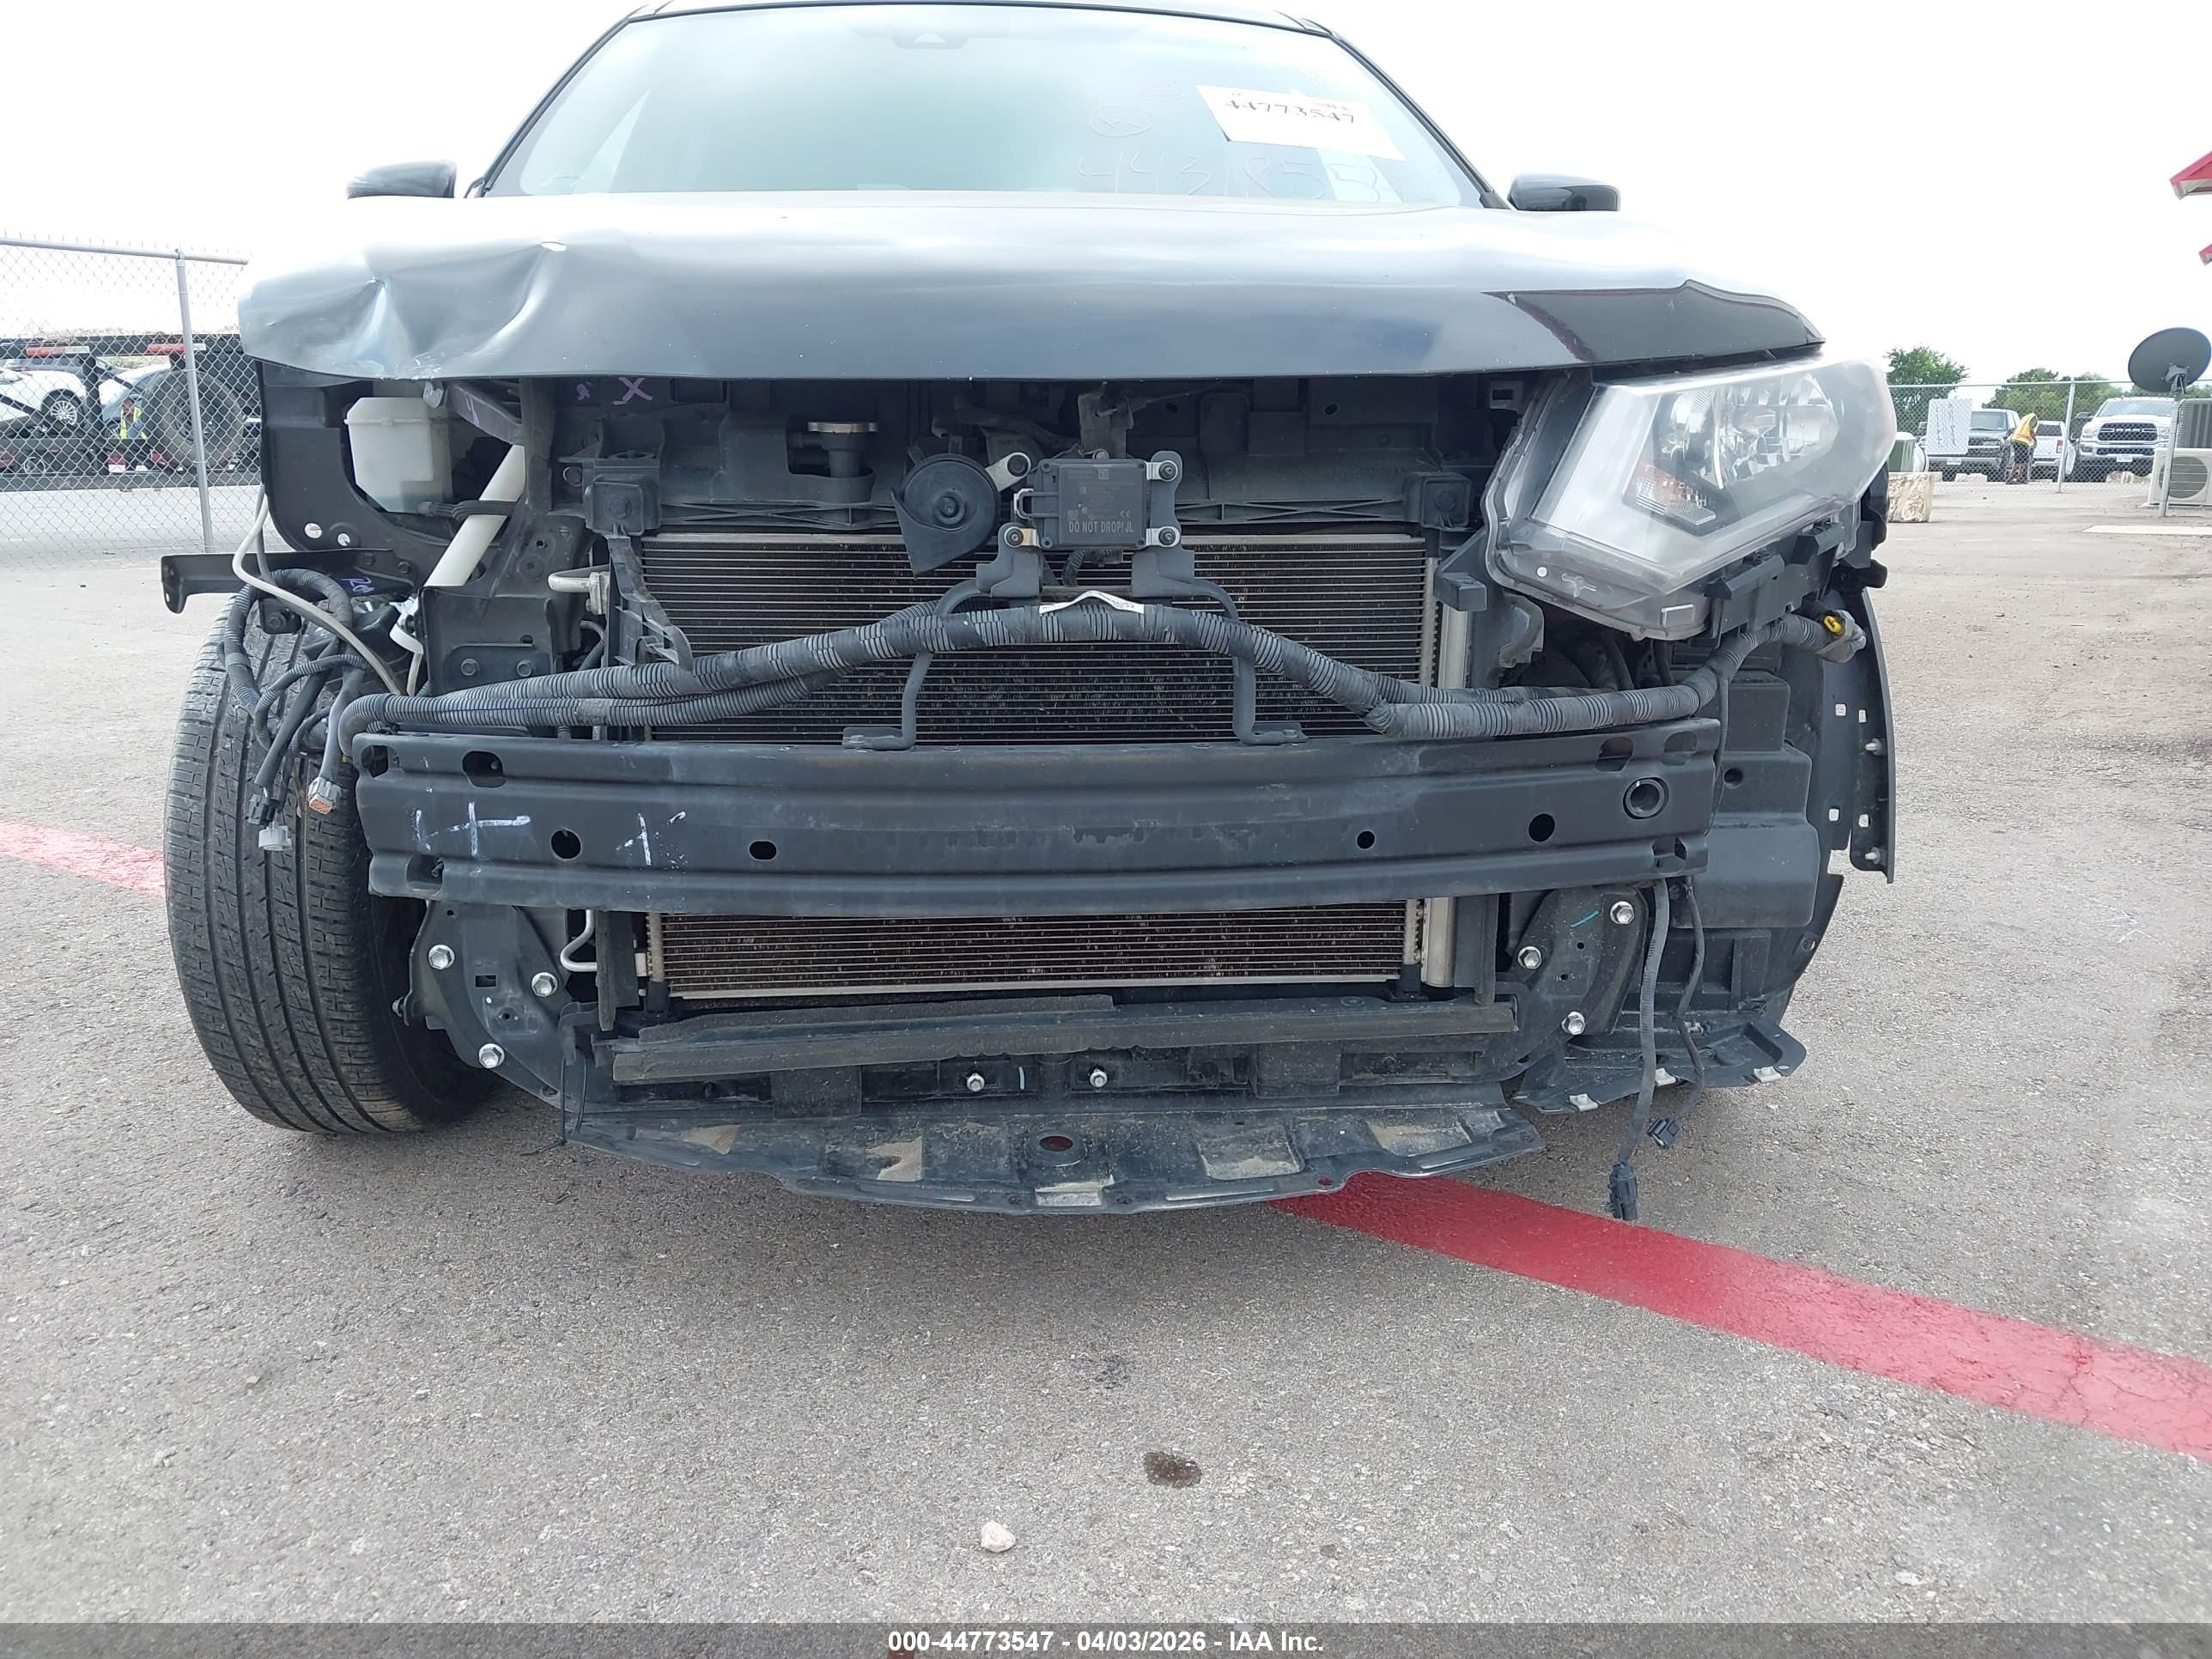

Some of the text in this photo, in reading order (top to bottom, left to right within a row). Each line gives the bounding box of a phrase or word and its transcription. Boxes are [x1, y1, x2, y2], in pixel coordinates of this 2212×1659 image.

[1224, 97, 1355, 125] 44773547
[1068, 520, 1080, 533] DO
[1082, 520, 1099, 533] NOT
[1100, 520, 1124, 533] DROP!
